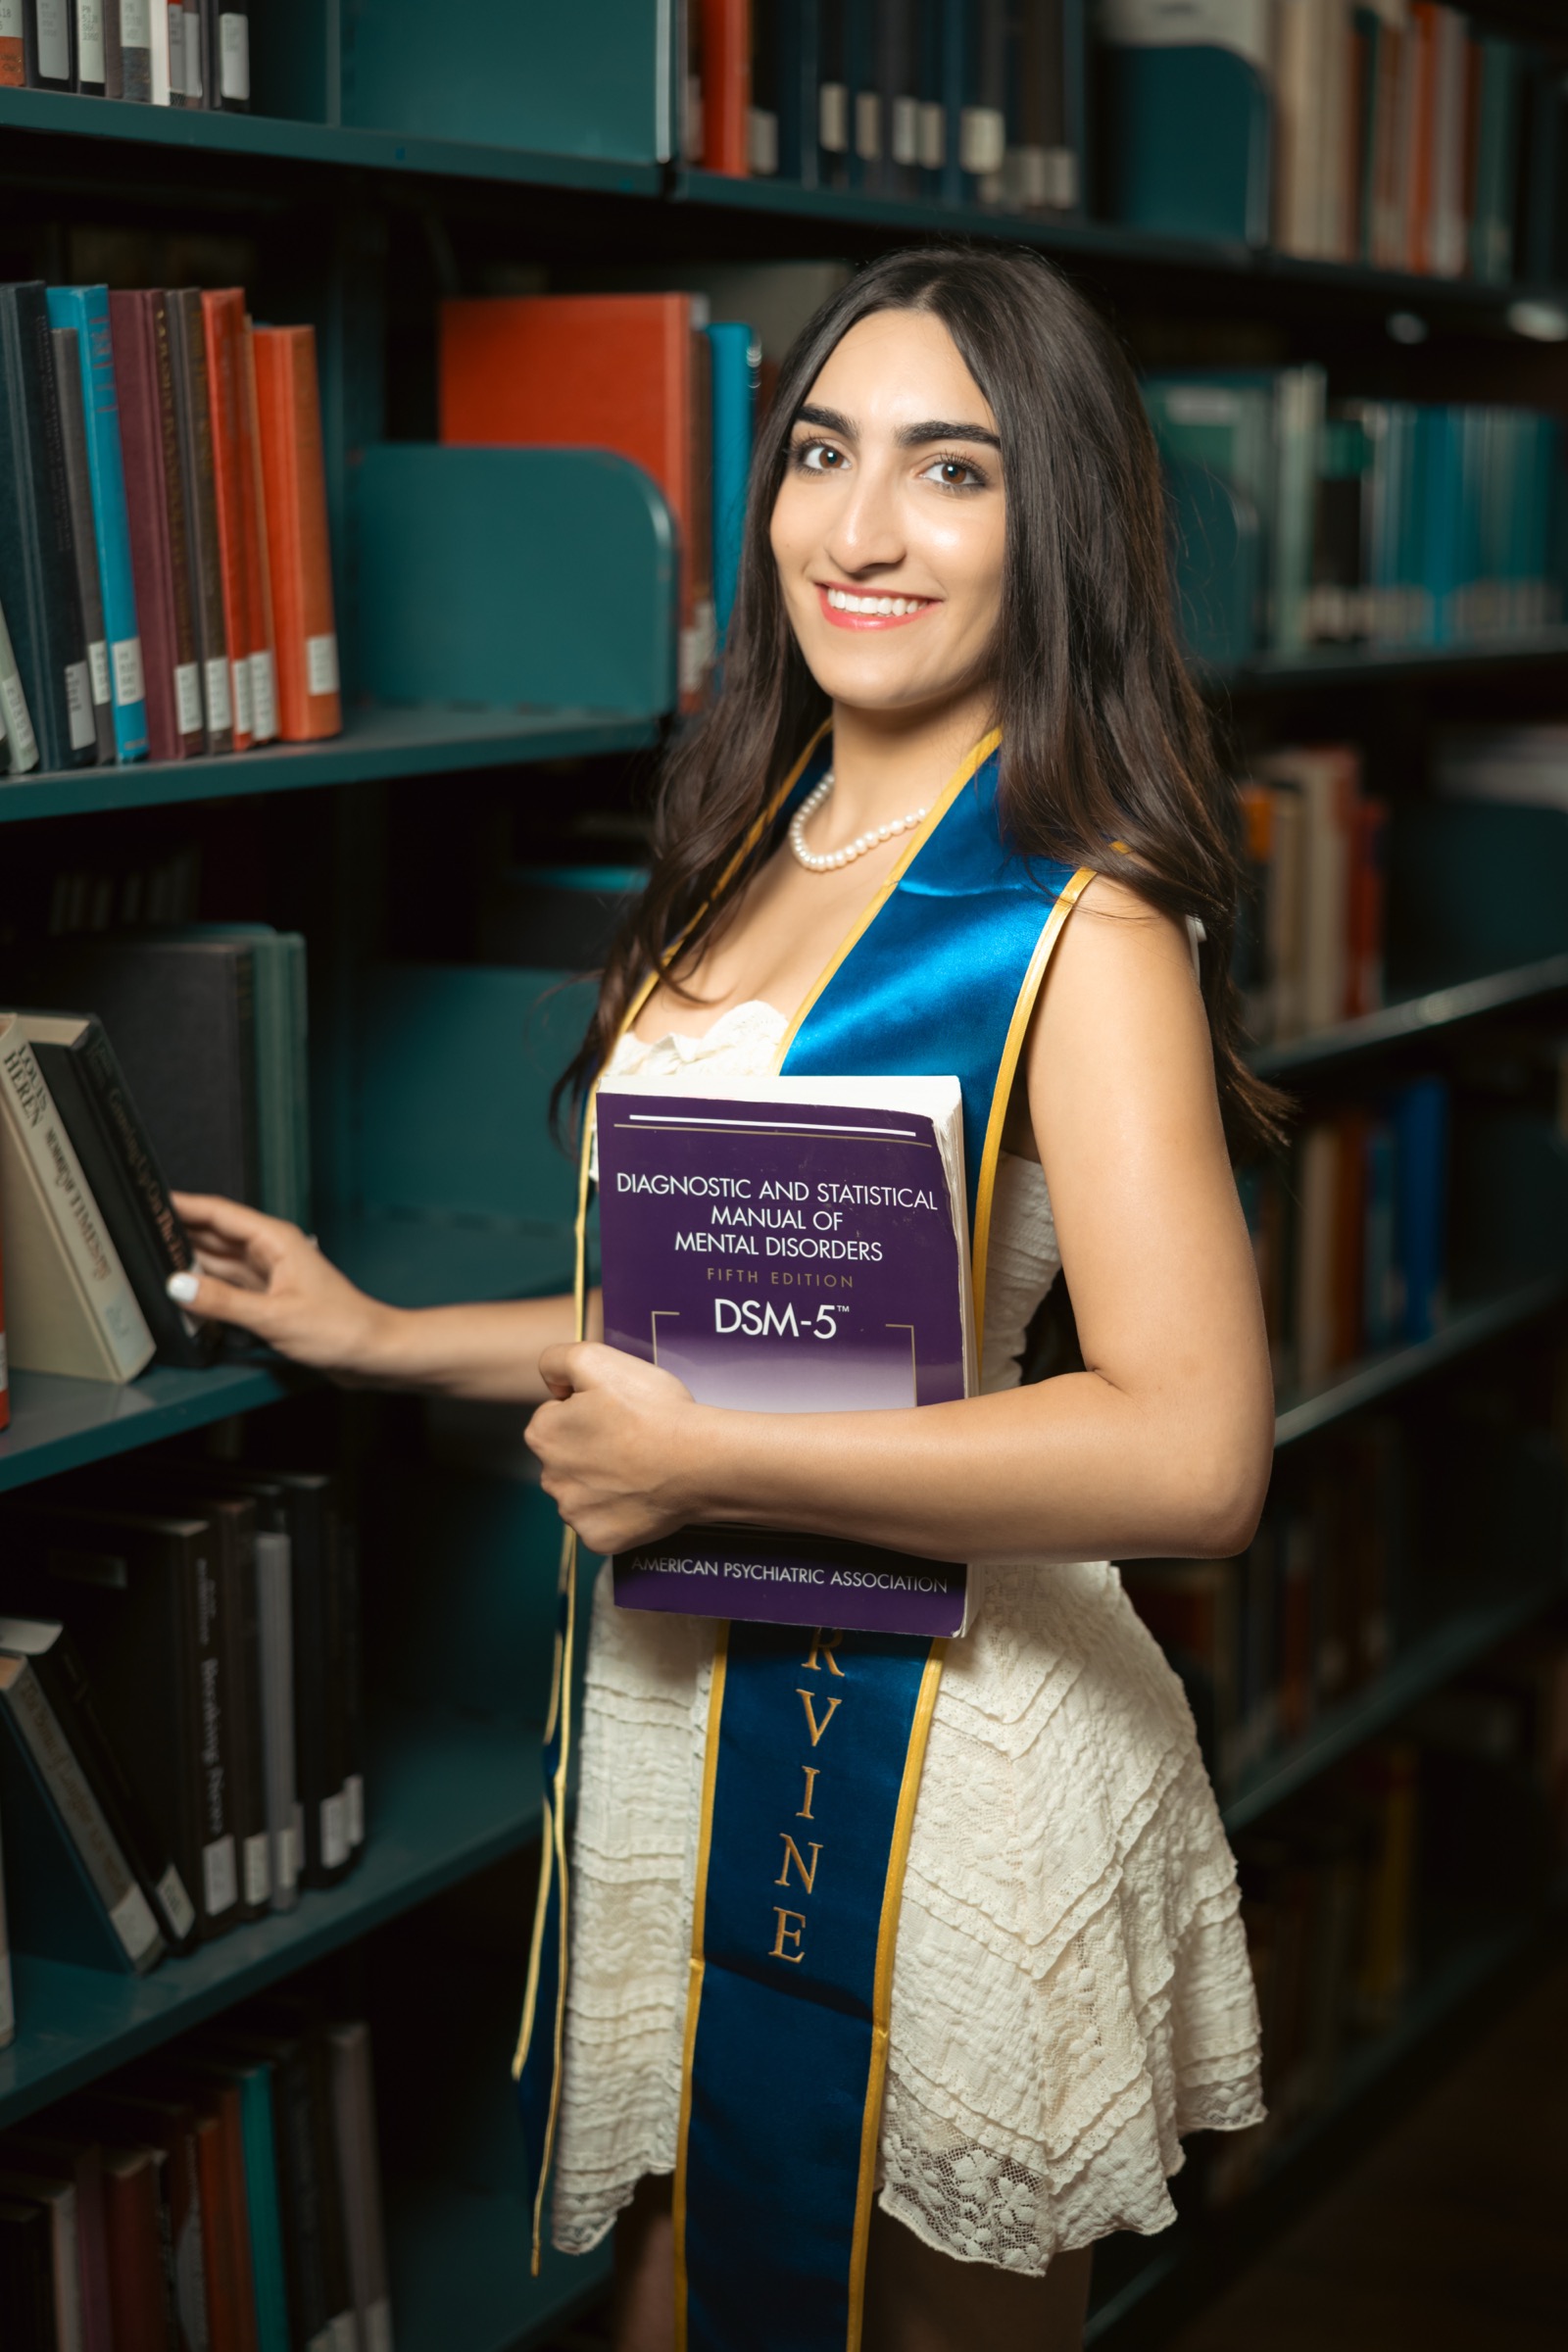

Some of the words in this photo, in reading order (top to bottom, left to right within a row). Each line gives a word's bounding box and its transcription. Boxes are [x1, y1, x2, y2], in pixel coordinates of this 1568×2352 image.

[4, 1051, 44, 1128] HEREN
[18, 1044, 49, 1112] LOUIS
[616, 1172, 752, 1199] DIAGNOSTIC
[759, 1180, 809, 1201] AND
[816, 1183, 938, 1210] STATISTICAL
[68, 1192, 104, 1260] TIMES
[711, 1204, 807, 1230] MANUAL
[812, 1210, 843, 1231] OF
[674, 1231, 760, 1255] MENTAL
[765, 1236, 883, 1262] DISORDERS
[707, 1267, 759, 1284] FIFTH
[770, 1271, 854, 1288] EDITION
[631, 1557, 718, 1577] AMERICAN
[723, 1562, 825, 1585] PSYCHIATRIC
[830, 1570, 948, 1593] ASSOCIATION
